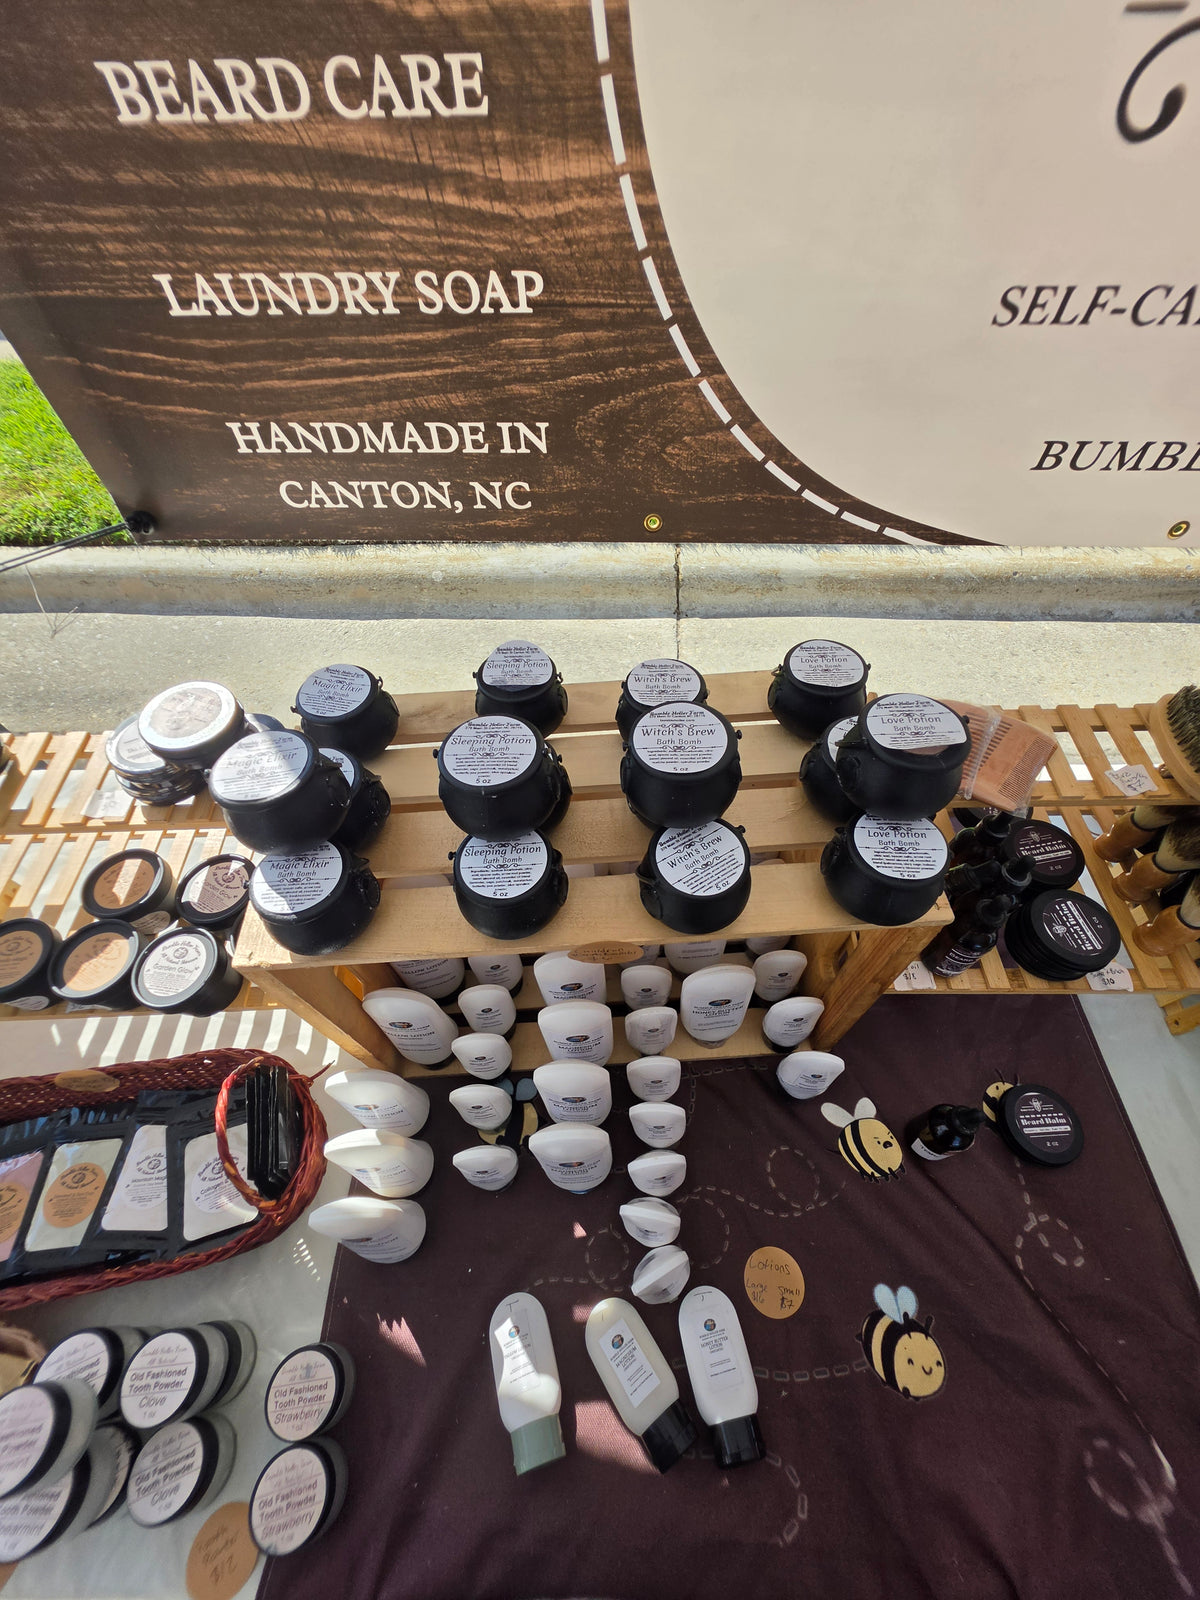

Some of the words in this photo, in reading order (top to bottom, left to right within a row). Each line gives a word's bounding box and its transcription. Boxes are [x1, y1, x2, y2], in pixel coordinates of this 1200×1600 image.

[94, 57, 311, 125] BEARD
[323, 52, 489, 119] CARE
[152, 271, 401, 316] LAUNDRY
[414, 270, 544, 314] SOAP
[991, 285, 1200, 328] SELF-CA
[226, 421, 489, 454] HANDMADE
[499, 421, 549, 454] IN
[279, 480, 464, 513] CANTON,
[473, 481, 533, 510] NC
[486, 661, 520, 671] Sleeping
[312, 680, 338, 690] Magic
[340, 684, 362, 692] Elixir
[642, 728, 683, 736] Witch's
[688, 728, 716, 736] Brew
[451, 737, 494, 747] Sleeping
[226, 756, 262, 769] Magic
[266, 752, 297, 764] Elixir
[867, 830, 890, 838] Love
[894, 830, 927, 838] Potion
[464, 847, 507, 858] Sleeping
[510, 846, 542, 854] Potion
[667, 848, 701, 869] Witch's
[700, 836, 722, 851] Brew
[1021, 848, 1044, 856] Beard
[1045, 844, 1067, 852] Balm
[270, 862, 300, 872] Magic
[302, 860, 330, 869] Elixir
[684, 858, 700, 870] Bath
[701, 849, 719, 861] Bomb
[296, 870, 317, 878] Bomb
[715, 882, 721, 891] 5
[722, 880, 730, 888] oz
[1060, 904, 1076, 925] Balm
[1074, 926, 1094, 950] Beard
[153, 962, 176, 972] Garden
[1020, 1118, 1044, 1126] Beard
[1044, 1116, 1066, 1124] Balm
[749, 1256, 790, 1276] Lotions
[746, 1278, 768, 1293] Large
[130, 1372, 145, 1382] Old
[146, 1367, 188, 1380] Fashioned
[129, 1383, 152, 1394] Tooth
[153, 1380, 184, 1391] Powder
[274, 1388, 288, 1398] Old
[289, 1381, 328, 1396] Fashioned
[138, 1396, 166, 1408] Clove
[274, 1398, 296, 1409] Tooth
[298, 1394, 327, 1406] Powder
[274, 1408, 324, 1425] Strawberry
[135, 1472, 151, 1486] Old
[152, 1448, 196, 1478] Fashioned
[136, 1480, 161, 1498] Tooth
[162, 1461, 196, 1482] Powder
[150, 1482, 181, 1506] Clove
[258, 1496, 274, 1510] Old
[275, 1480, 318, 1503] Fashioned
[260, 1506, 284, 1523] Tooth
[286, 1494, 316, 1513] Powder
[261, 1510, 315, 1540] Strawberry
